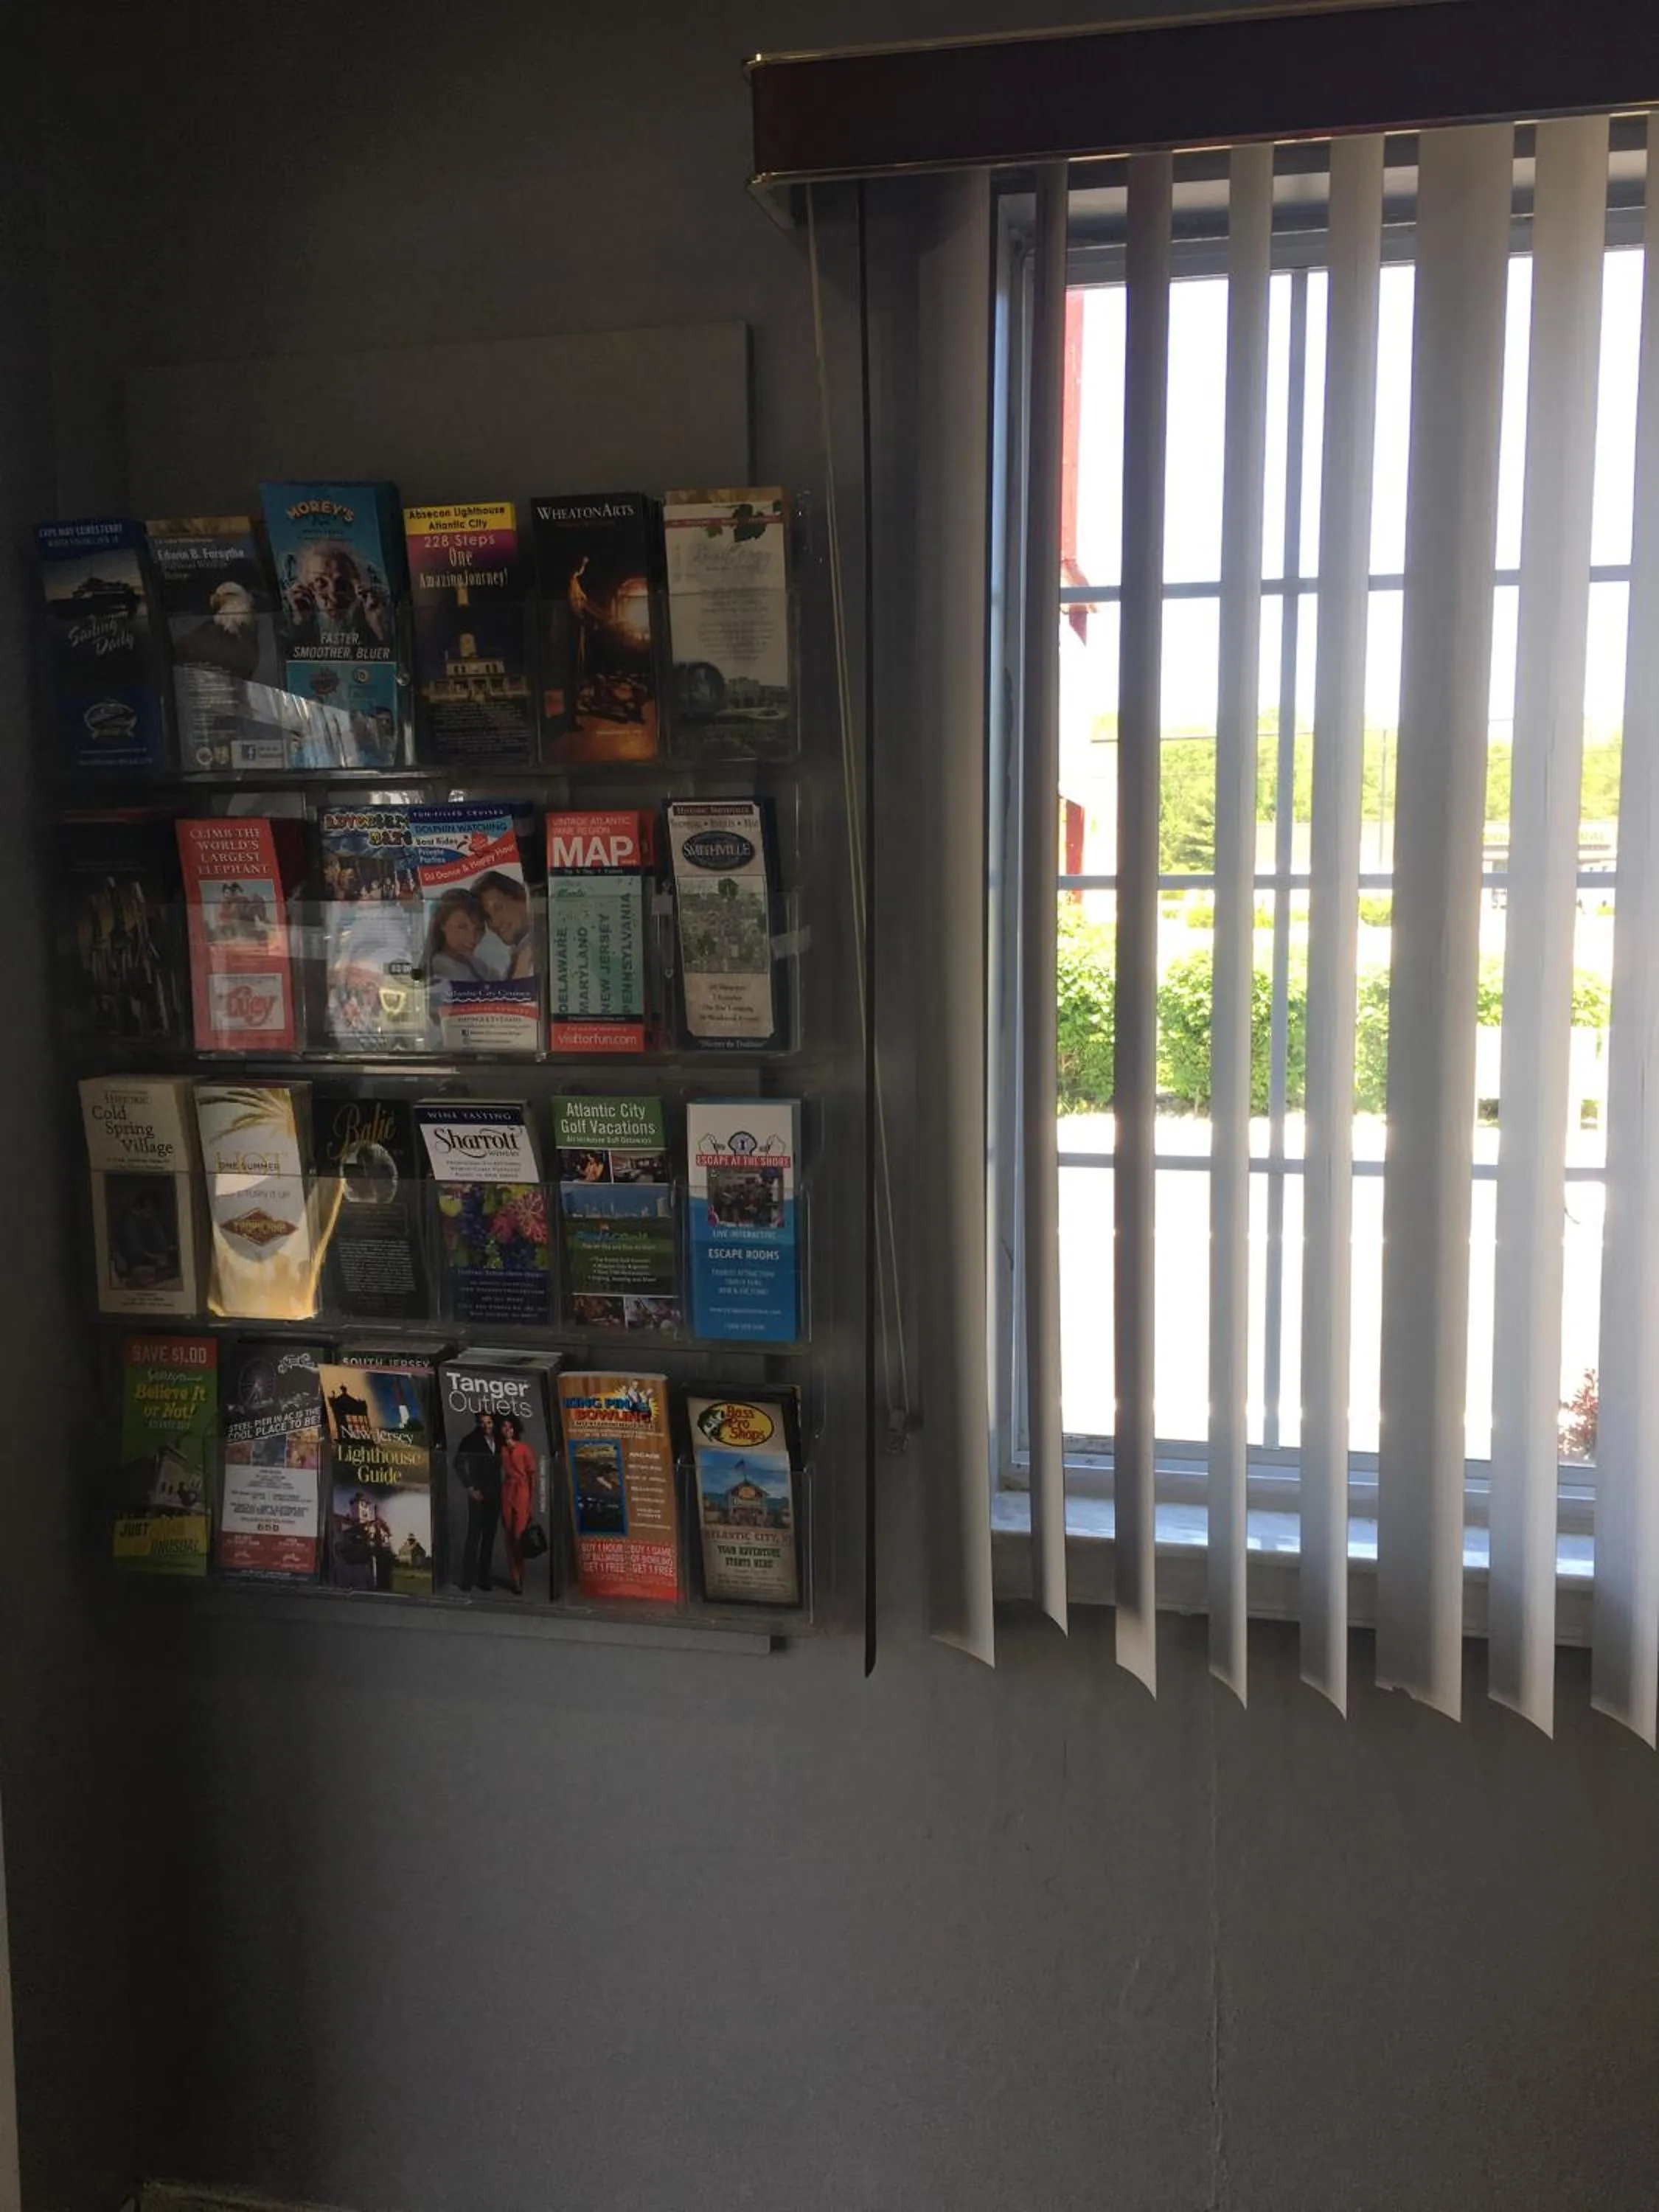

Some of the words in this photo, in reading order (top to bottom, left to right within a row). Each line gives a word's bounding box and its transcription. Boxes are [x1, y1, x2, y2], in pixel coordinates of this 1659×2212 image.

[286, 499, 355, 522] MOREY'S
[409, 509, 450, 519] Absecon
[454, 507, 504, 518] Lighthouse
[429, 521, 465, 529] Atlantic
[469, 519, 487, 528] City
[424, 534, 449, 548] 228
[453, 533, 495, 548] Steps
[449, 546, 473, 567] One
[92, 631, 133, 655] Daily
[356, 647, 390, 659] BLUER
[415, 825, 456, 834] DOLPHIN
[457, 821, 508, 833] WATCHING
[195, 840, 260, 850] WORLD'S
[552, 835, 634, 867] MAP
[684, 842, 751, 857] SMITHVILLE
[201, 852, 260, 862] LARGEST
[198, 863, 271, 874] ELEPHANT
[598, 914, 611, 974] JERSEY
[620, 893, 633, 1013] PENNSYLVANIA
[557, 926, 568, 1013] DELAWARE
[577, 926, 589, 1013] MARYLAND
[600, 978, 611, 1013] NEW
[91, 1105, 127, 1120] Cold
[566, 1102, 616, 1119] Atlantic
[619, 1102, 647, 1120] City
[105, 1121, 154, 1138] Spring
[560, 1119, 587, 1133] Golf
[589, 1119, 656, 1136] Vacations
[121, 1137, 175, 1157] Village
[434, 1127, 522, 1155] Sharrott
[708, 1248, 743, 1259] ESCAPE
[746, 1249, 779, 1261] ROOMS
[133, 1344, 169, 1363] SAVE
[172, 1346, 207, 1364] $1.00
[342, 1356, 383, 1367] SOUTH
[389, 1358, 431, 1369] JERSEY
[133, 1383, 189, 1401] Believe
[192, 1385, 207, 1402] It
[445, 1371, 531, 1399] Tanger
[143, 1406, 160, 1418] or
[161, 1402, 198, 1419] Not!
[448, 1390, 534, 1419] Outlets
[726, 1405, 755, 1419] Bass
[575, 1409, 653, 1423] BOWLING
[255, 1423, 288, 1437] PLACE
[340, 1424, 371, 1440] New
[373, 1428, 414, 1446] Jersey
[729, 1427, 765, 1442] Shops
[338, 1444, 424, 1467] Lighthouse
[358, 1464, 402, 1485] Guide
